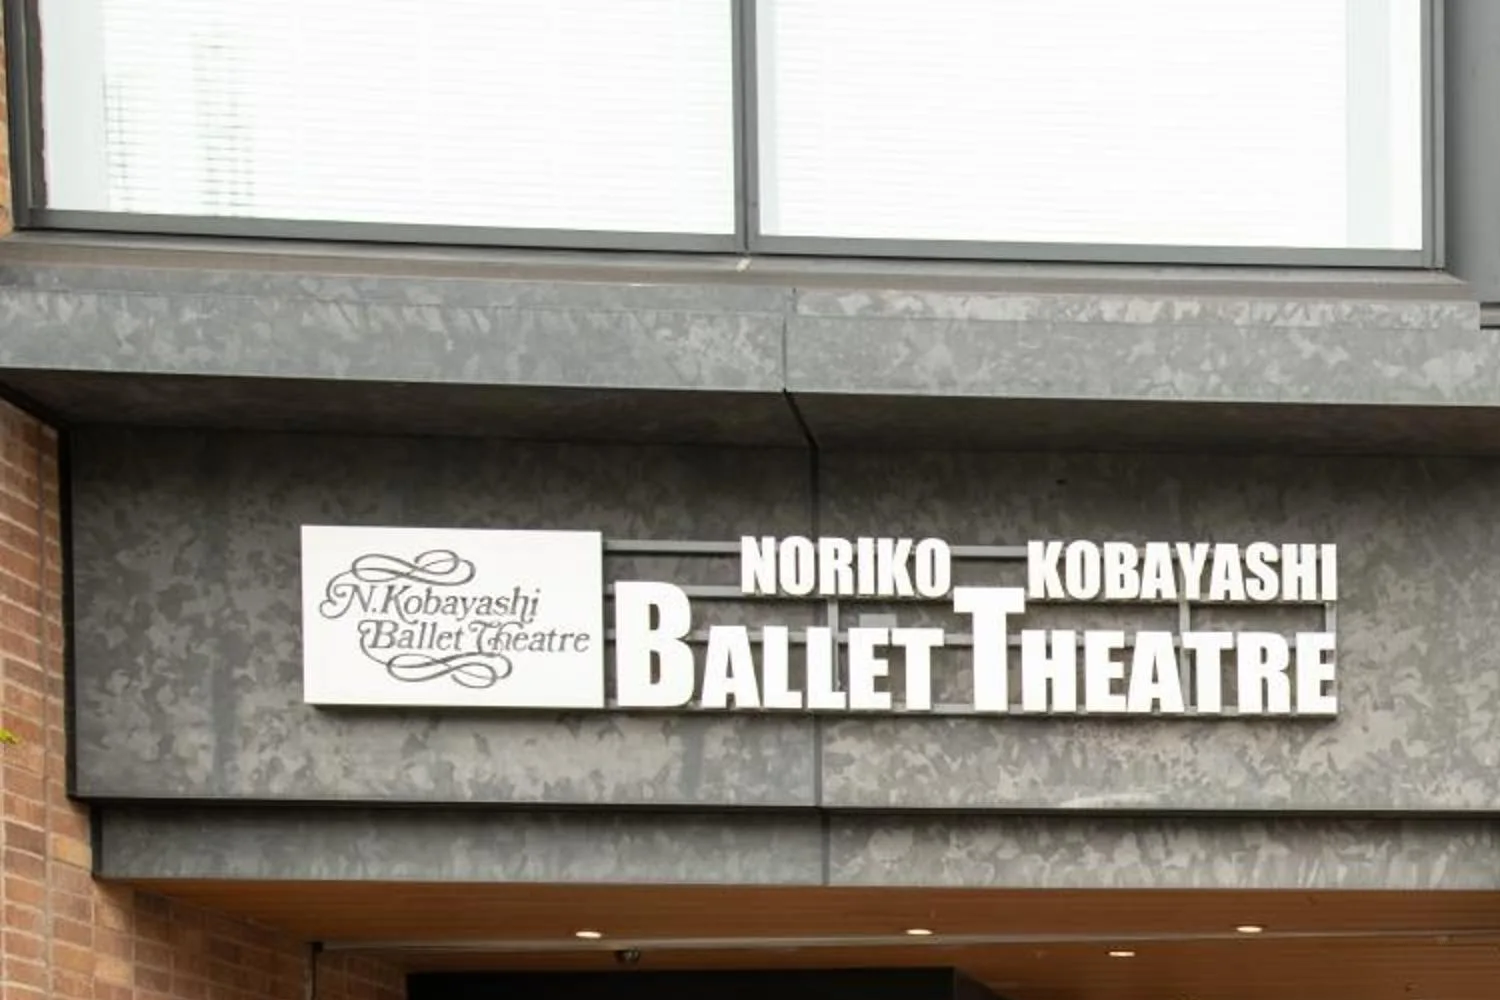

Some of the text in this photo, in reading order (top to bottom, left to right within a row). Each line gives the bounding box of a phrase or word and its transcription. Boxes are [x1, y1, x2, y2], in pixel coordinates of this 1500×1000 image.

[741, 535, 1338, 601] NORIKO KOBAYASHI
[319, 583, 541, 625] N.Kobayashi
[357, 619, 591, 654] Ballet Theatre
[614, 581, 1338, 714] BALLET THEATRE
